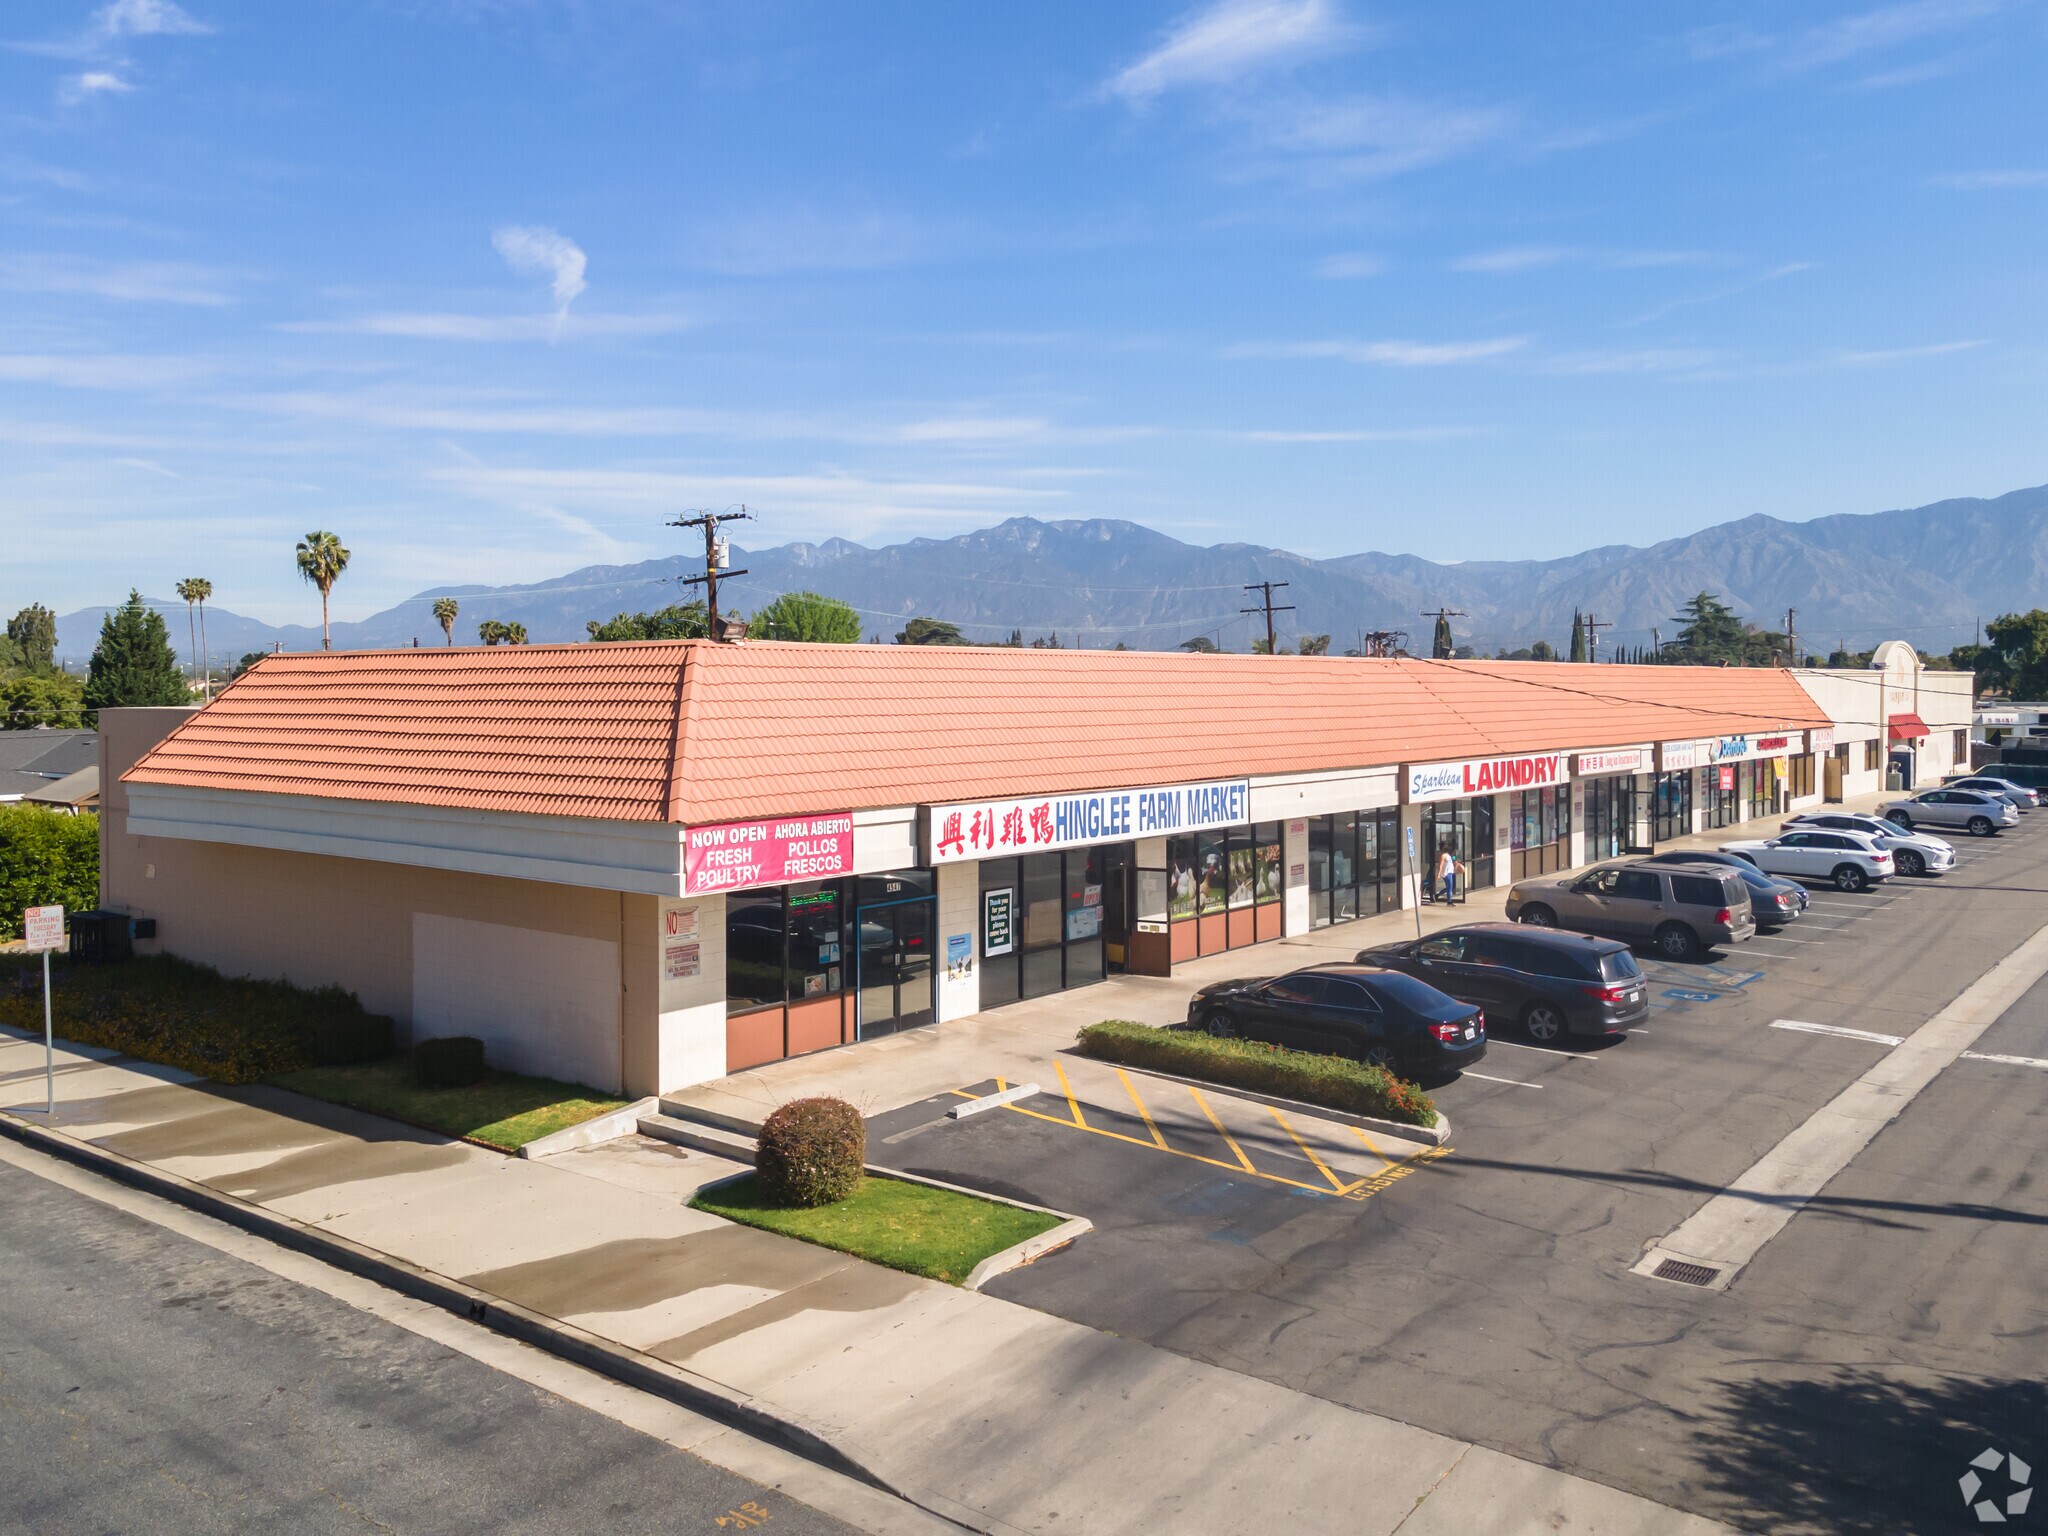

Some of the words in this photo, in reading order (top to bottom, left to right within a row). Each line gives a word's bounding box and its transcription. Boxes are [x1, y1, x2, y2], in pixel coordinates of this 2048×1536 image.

[1412, 768, 1461, 794] Sparklean
[1463, 756, 1558, 793] LAUNDRY
[1056, 796, 1130, 841] HINGLEE
[1139, 791, 1181, 831] FARM
[1187, 785, 1245, 825] MARKET
[692, 830, 725, 848] NOW
[729, 826, 766, 844] OPEN
[775, 822, 808, 840] AHORA
[811, 819, 850, 836] ABIERTO
[706, 847, 752, 867] FRESH
[788, 838, 837, 857] POLLOS
[697, 864, 761, 887] POULTRY
[784, 855, 842, 876] FRESCOS
[990, 898, 1001, 906] Thank
[29, 916, 60, 925] PARKING
[666, 911, 678, 936] NO
